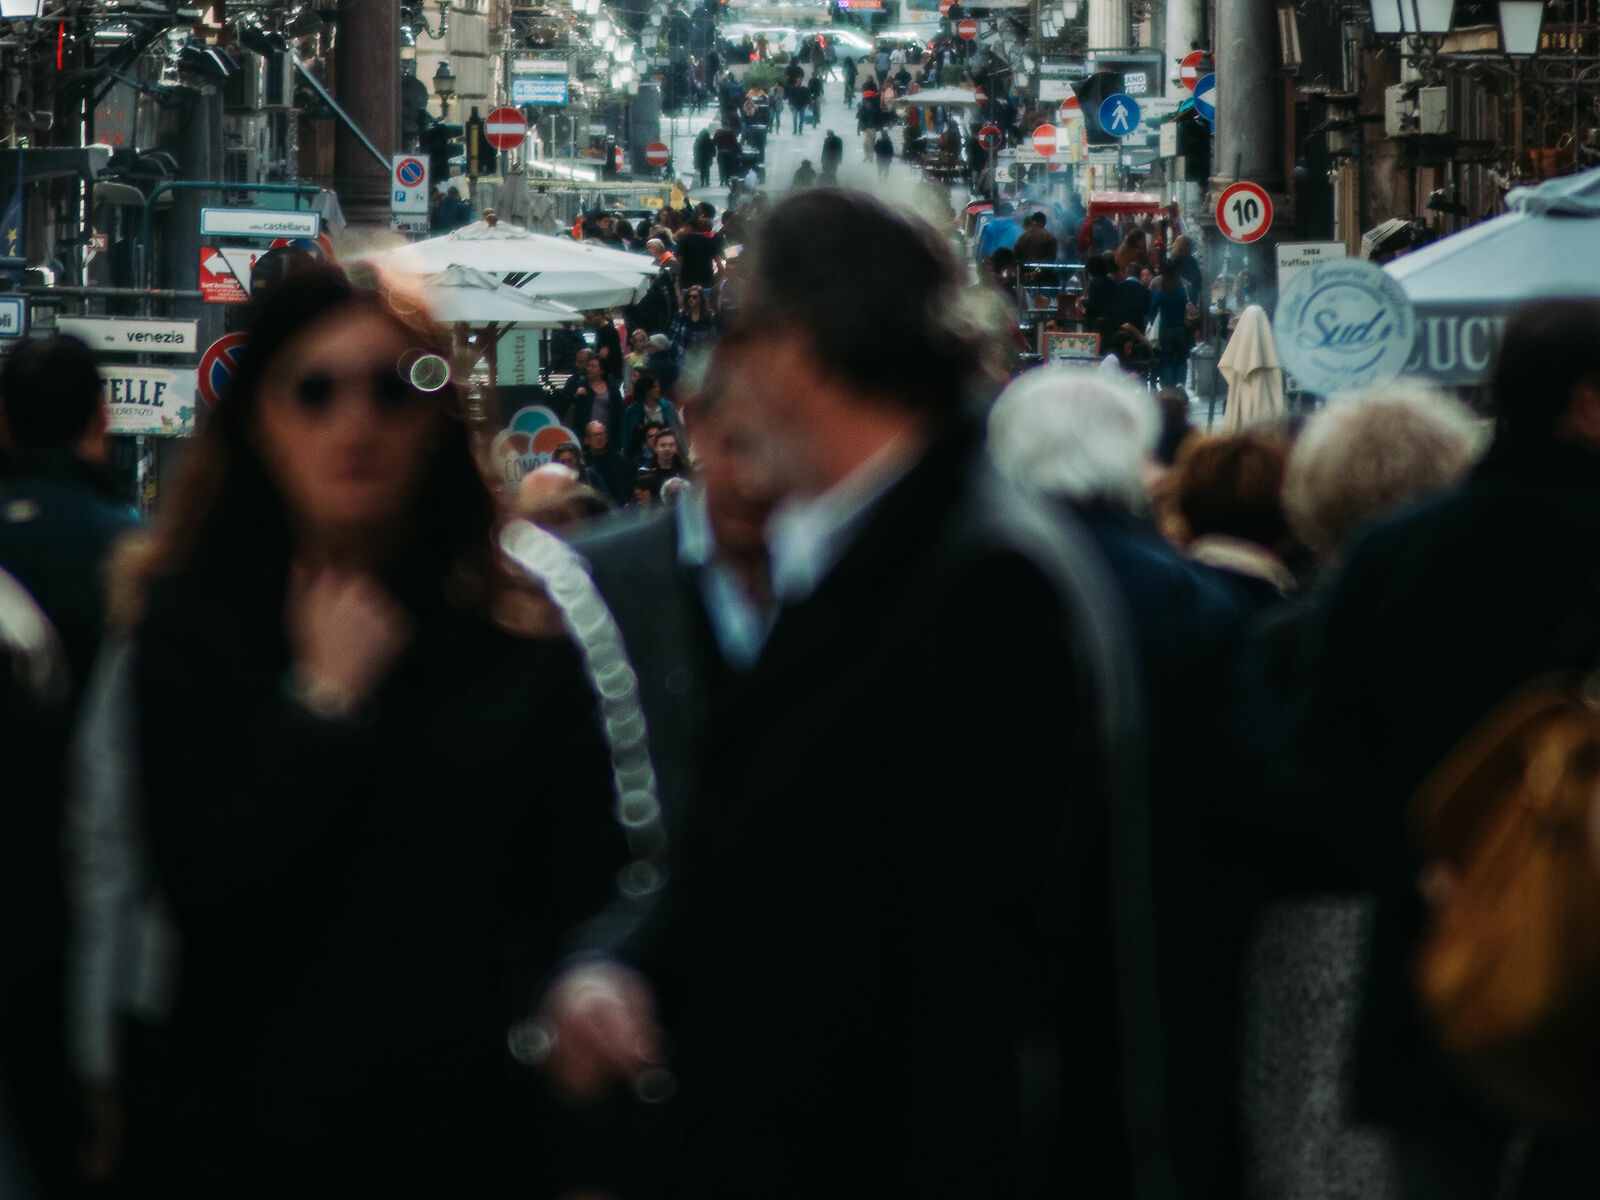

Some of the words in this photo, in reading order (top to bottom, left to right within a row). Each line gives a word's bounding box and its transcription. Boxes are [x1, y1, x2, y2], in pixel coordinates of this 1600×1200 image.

[1232, 198, 1259, 226] 10
[264, 222, 311, 232] castellana
[127, 330, 185, 344] venezia
